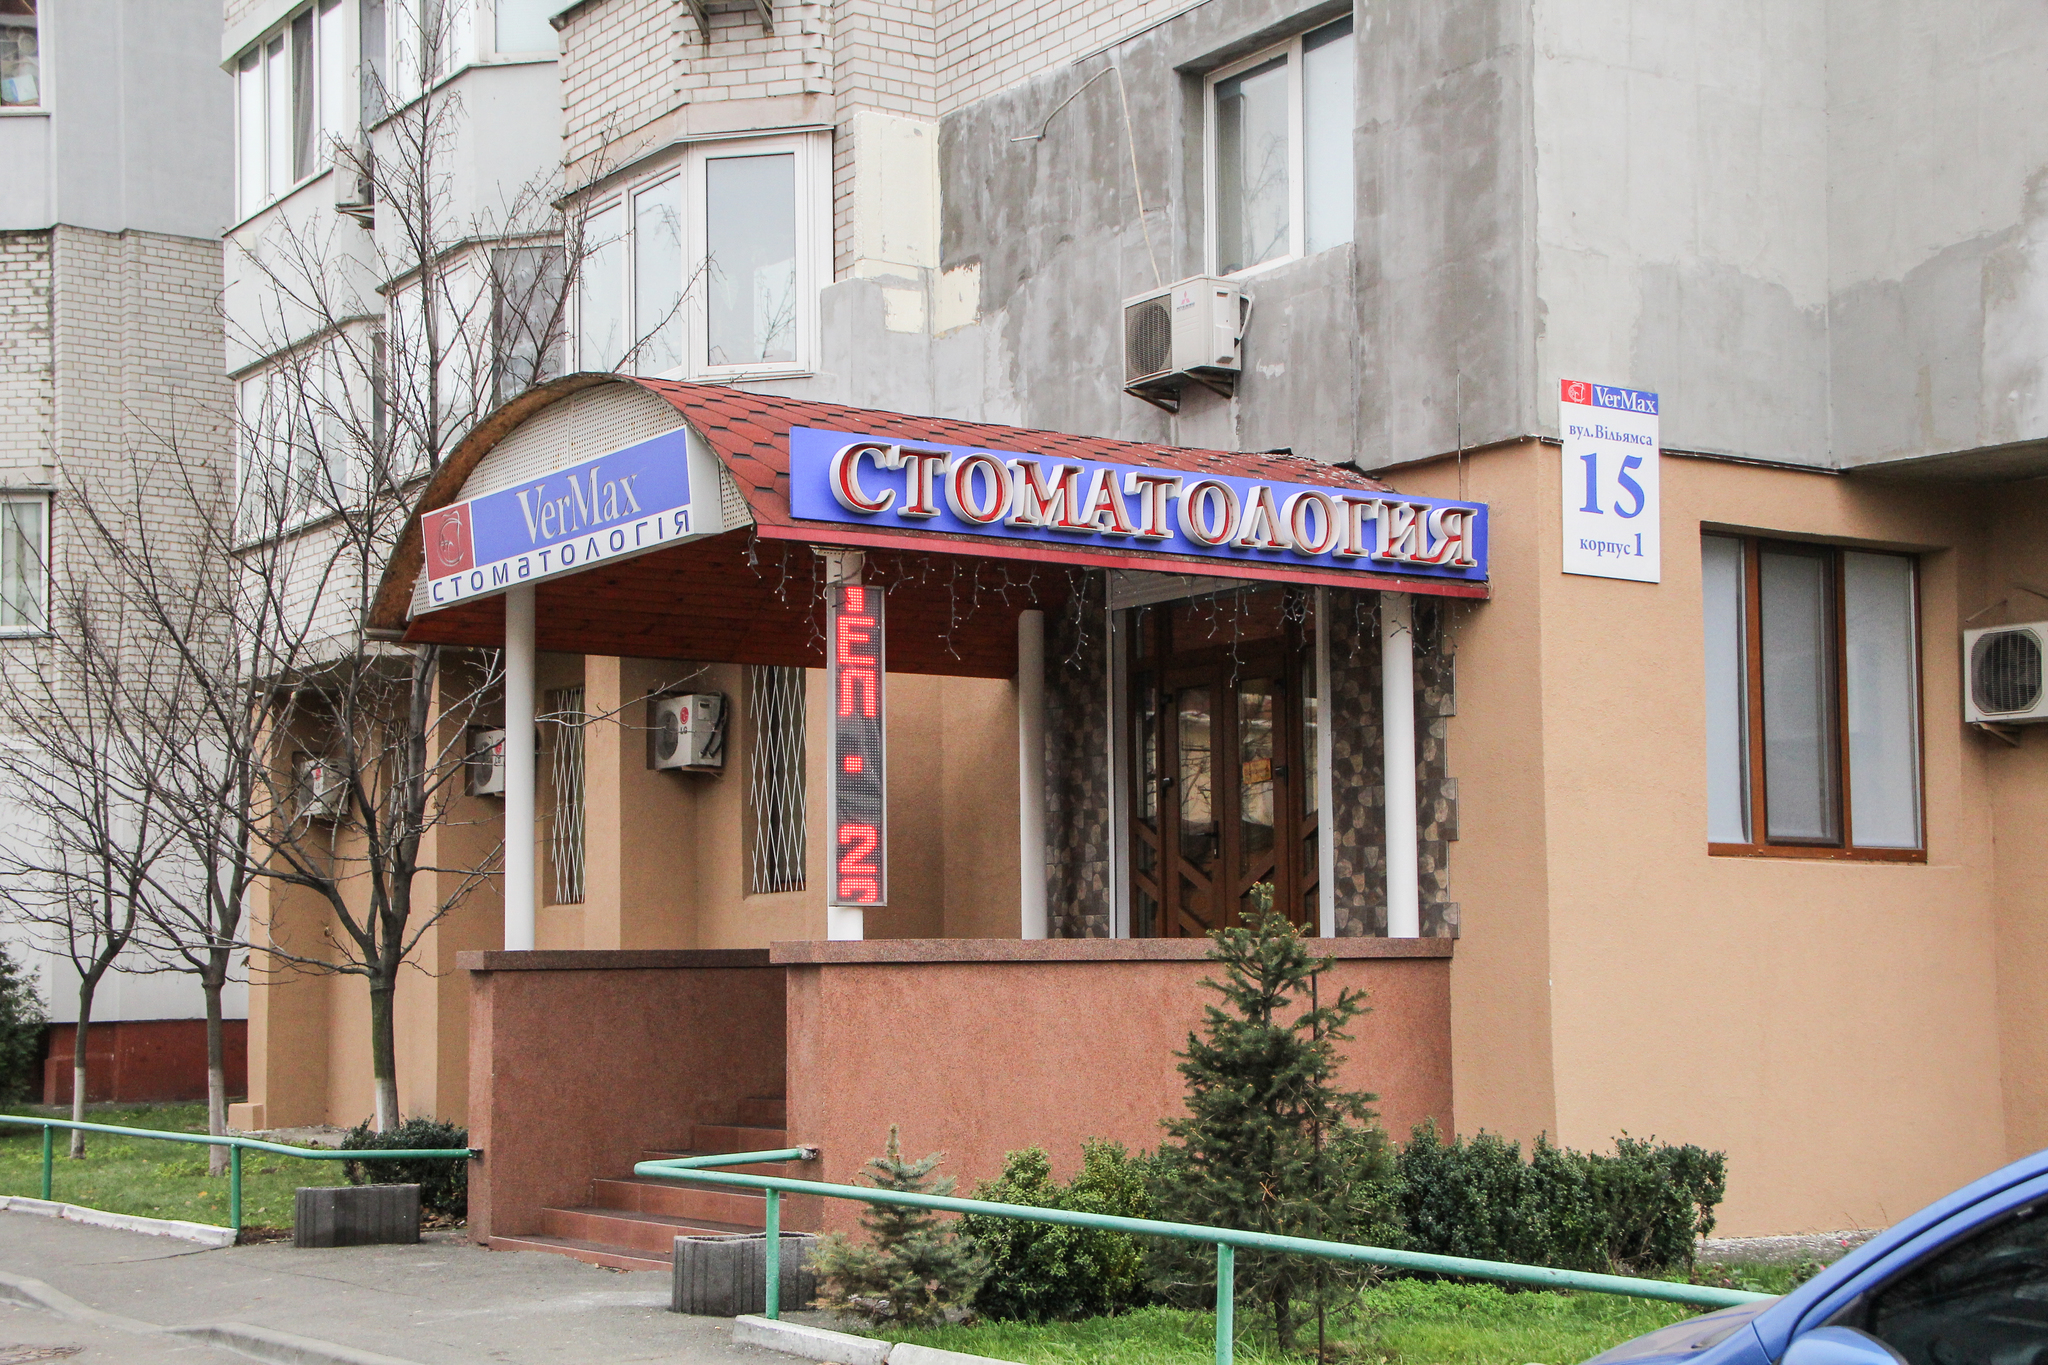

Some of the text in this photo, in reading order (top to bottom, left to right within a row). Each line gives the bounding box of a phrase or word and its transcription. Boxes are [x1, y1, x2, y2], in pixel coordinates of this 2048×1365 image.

[1594, 385, 1656, 414] VerMax
[516, 466, 641, 544] VerMax
[829, 441, 1478, 569] СТОМАТОЛОГИЯ
[1579, 453, 1645, 518] 15
[1579, 532, 1644, 558] корпус 1
